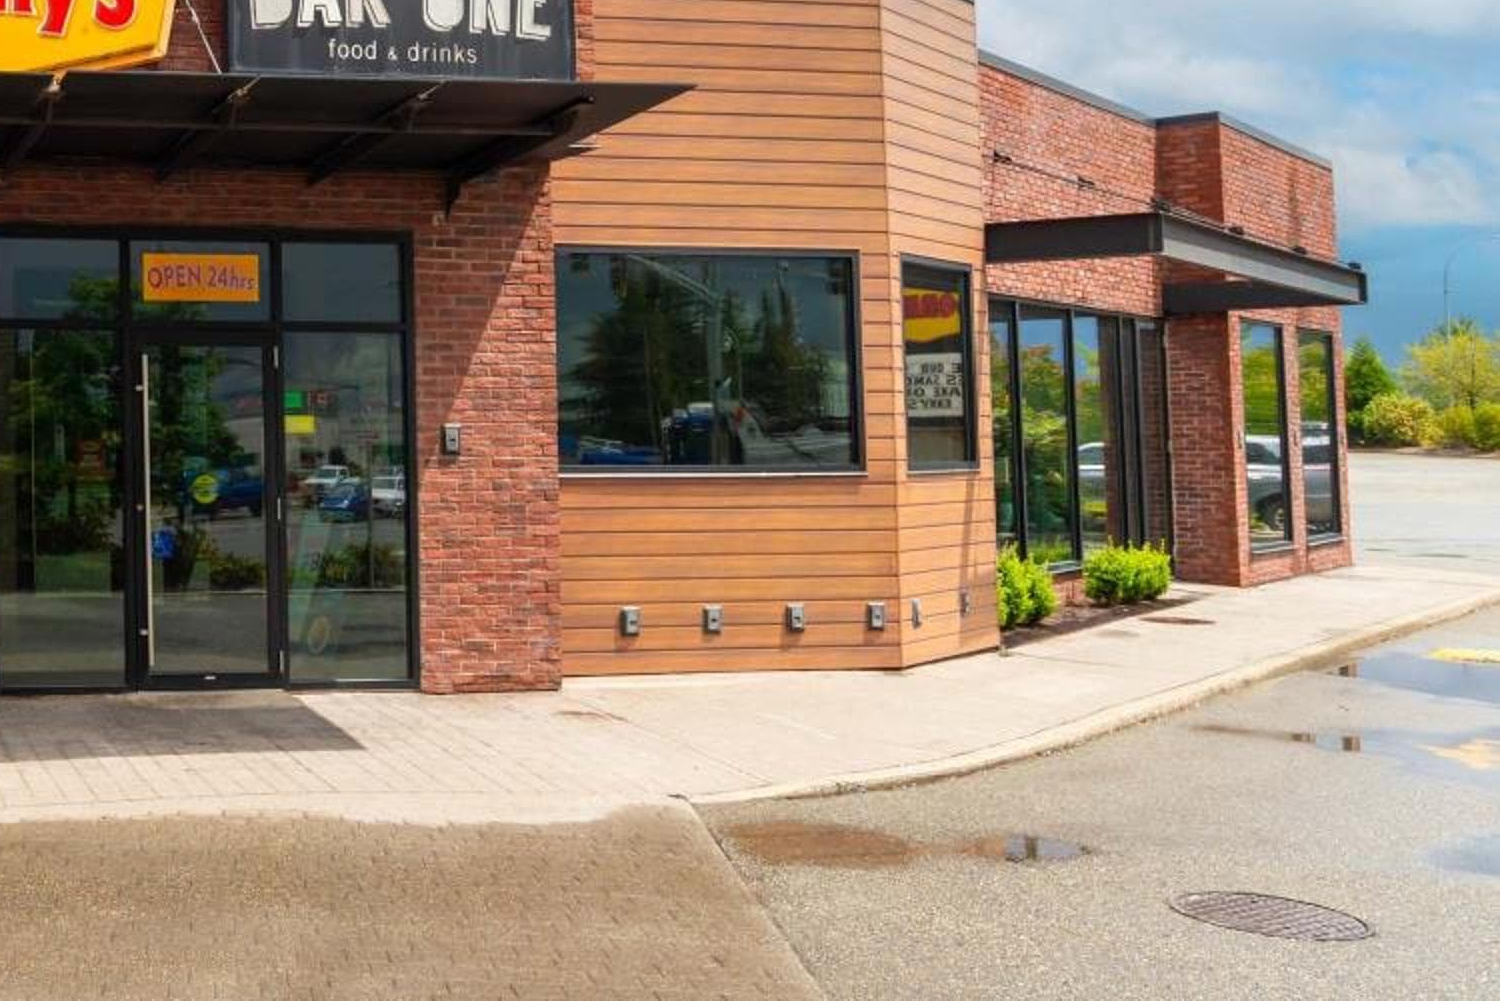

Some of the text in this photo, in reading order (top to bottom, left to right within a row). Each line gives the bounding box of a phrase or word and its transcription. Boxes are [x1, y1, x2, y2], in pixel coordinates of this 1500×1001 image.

[328, 38, 478, 64] food & drinks
[147, 264, 202, 289] OPEN
